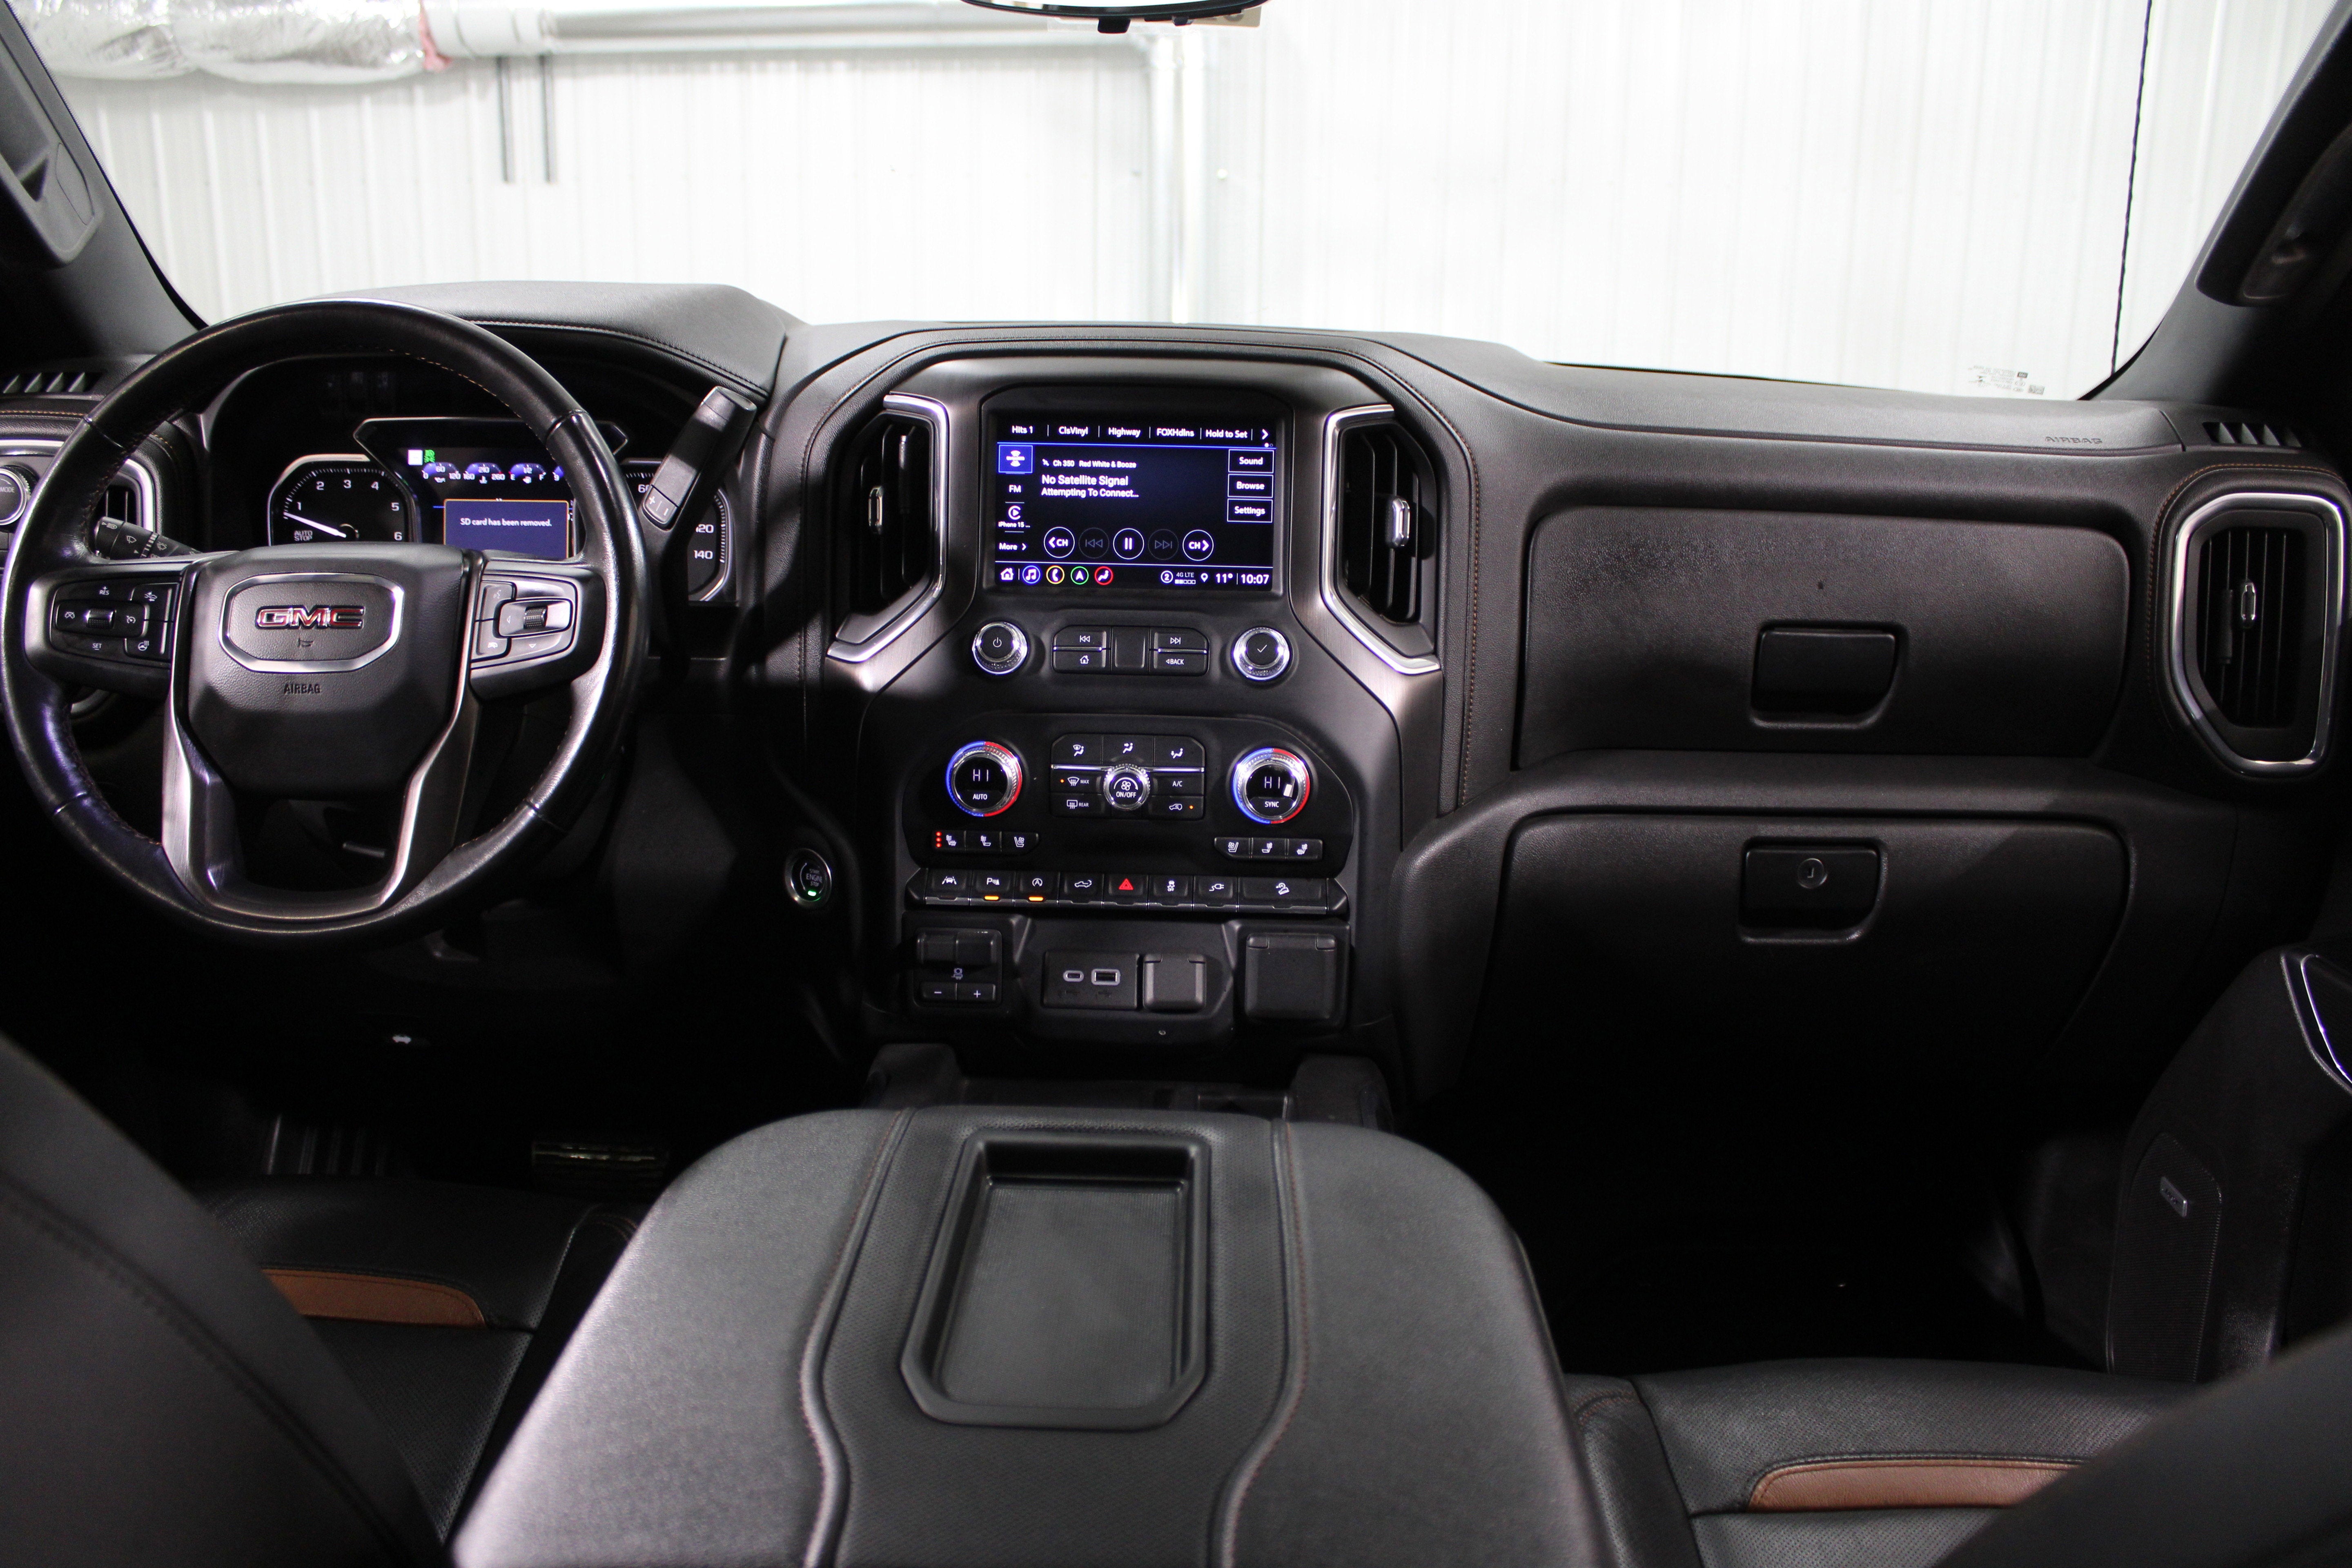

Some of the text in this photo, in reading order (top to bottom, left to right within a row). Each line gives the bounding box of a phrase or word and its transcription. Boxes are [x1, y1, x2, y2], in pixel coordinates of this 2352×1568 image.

[1011, 425, 1027, 434] Hits
[1108, 427, 1141, 438] Highway
[1205, 429, 1224, 438] Hold
[1235, 430, 1248, 438] Set
[2044, 436, 2103, 444] AIRBAG
[1238, 457, 1263, 465] Sound
[316, 481, 325, 490] 2
[343, 479, 352, 489] 3
[371, 481, 379, 490] 4
[1042, 474, 1128, 488] No Satellite Signal
[1236, 481, 1265, 490] Browse
[1009, 485, 1021, 493] FM
[1041, 487, 1086, 498] Attempting
[1087, 488, 1098, 497] To
[297, 502, 301, 510] 1
[391, 502, 400, 511] 5
[1234, 506, 1265, 516] Settings
[472, 518, 487, 526] card
[502, 518, 519, 526] been
[520, 519, 552, 527] removed.
[394, 532, 403, 541] 6
[694, 550, 713, 559] 140
[1241, 574, 1269, 584] 10:07
[256, 605, 365, 629] GMC
[283, 683, 321, 694] AIRBAG
